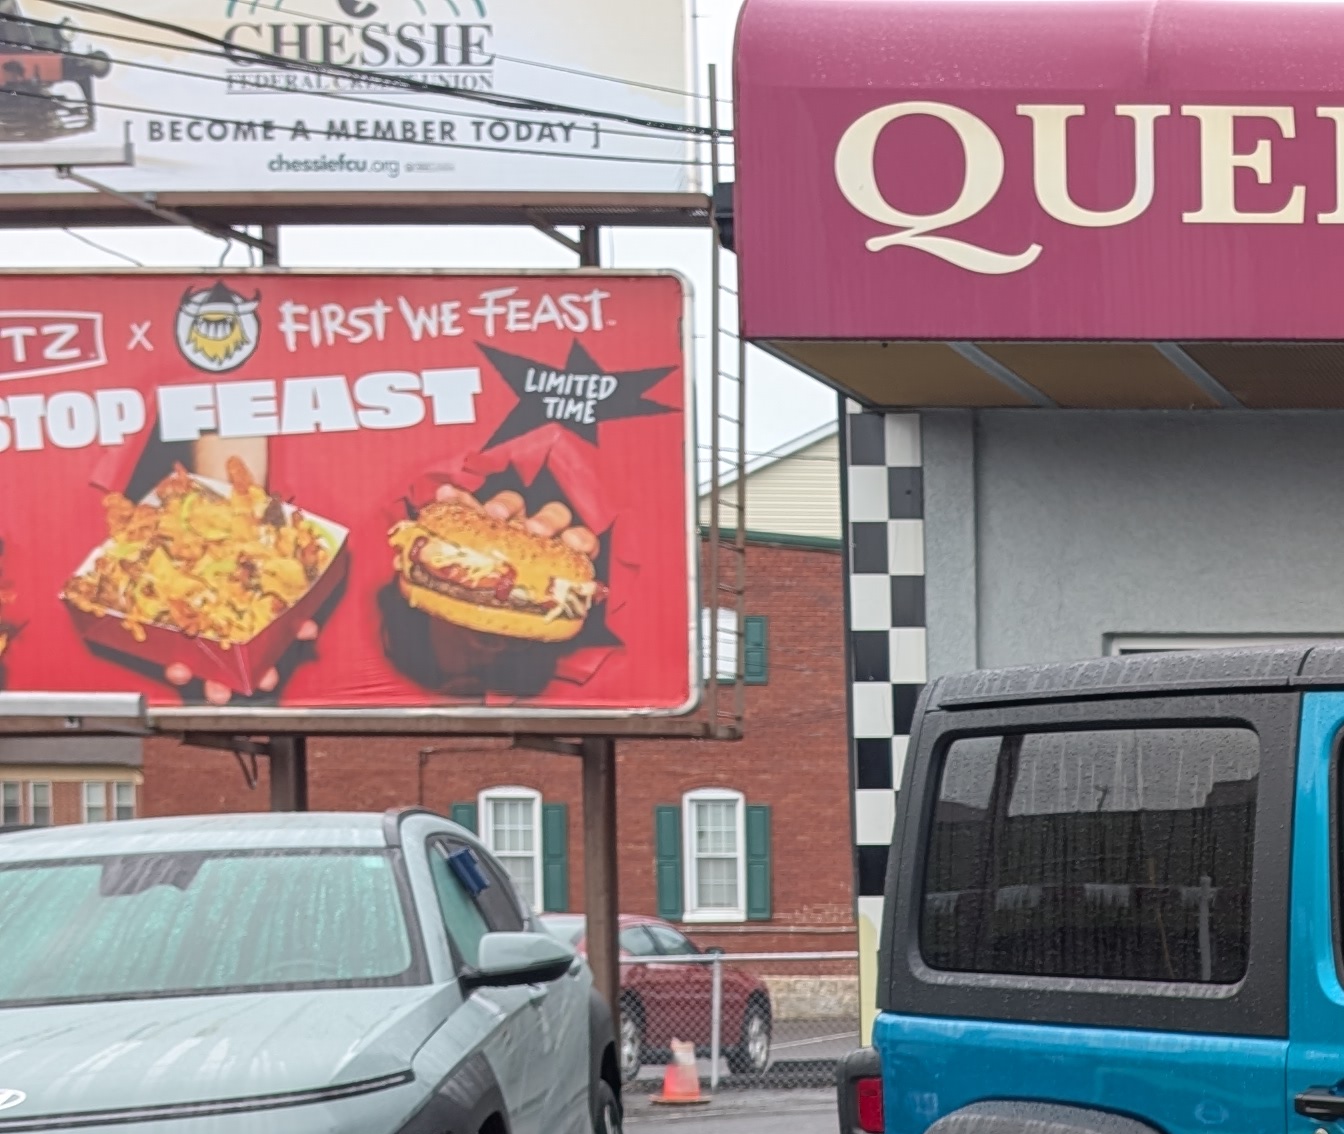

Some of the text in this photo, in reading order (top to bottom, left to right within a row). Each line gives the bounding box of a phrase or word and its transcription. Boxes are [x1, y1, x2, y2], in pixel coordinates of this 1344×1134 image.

[223, 22, 494, 68] CHESSIE
[148, 119, 575, 142] BECOME A MEMBER TODAY
[267, 153, 400, 178] chessiefcu.org
[278, 286, 611, 352] FIRST WE FEAST
[524, 368, 618, 401] LIMITED
[0, 367, 482, 451] TOP FEAST
[542, 397, 597, 424] TIME
